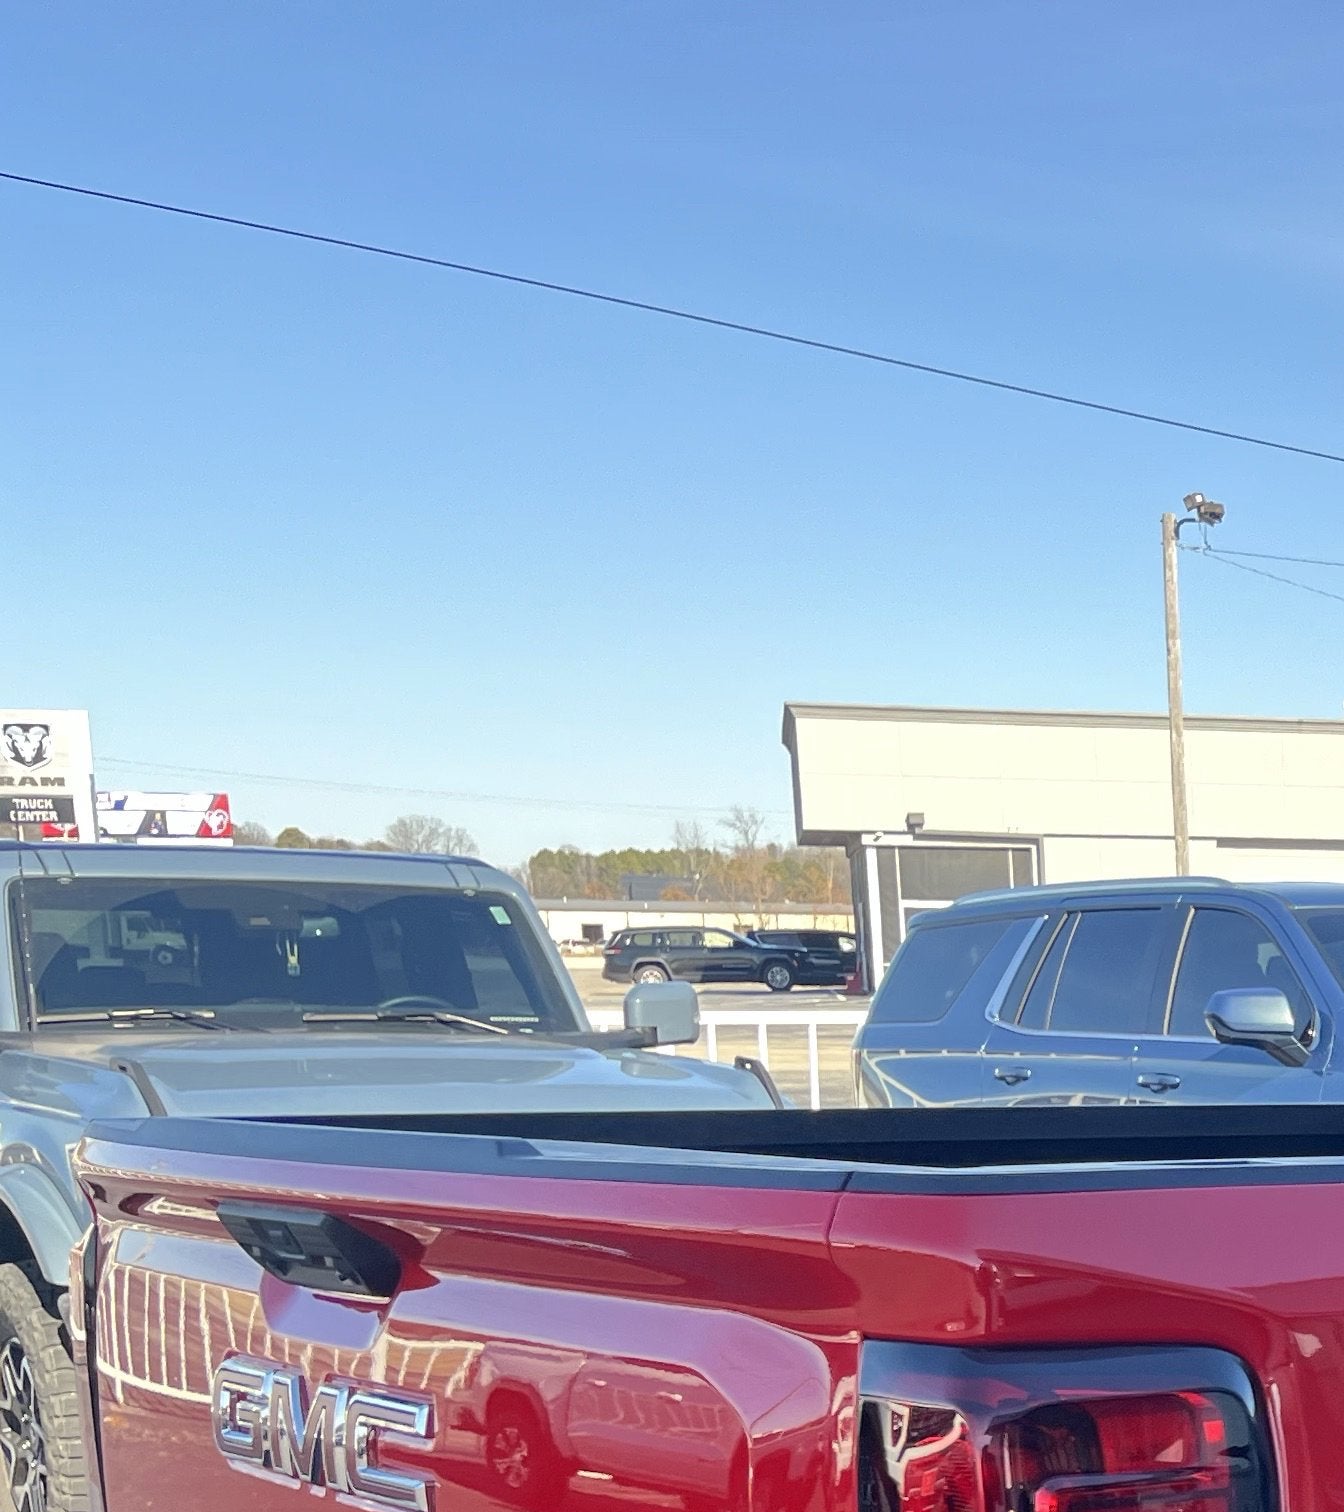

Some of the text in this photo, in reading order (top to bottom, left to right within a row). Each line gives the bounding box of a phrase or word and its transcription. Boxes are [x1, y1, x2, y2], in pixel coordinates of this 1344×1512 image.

[0, 776, 66, 787] RAM
[12, 798, 54, 809] TRUCK
[10, 810, 59, 822] CENTER
